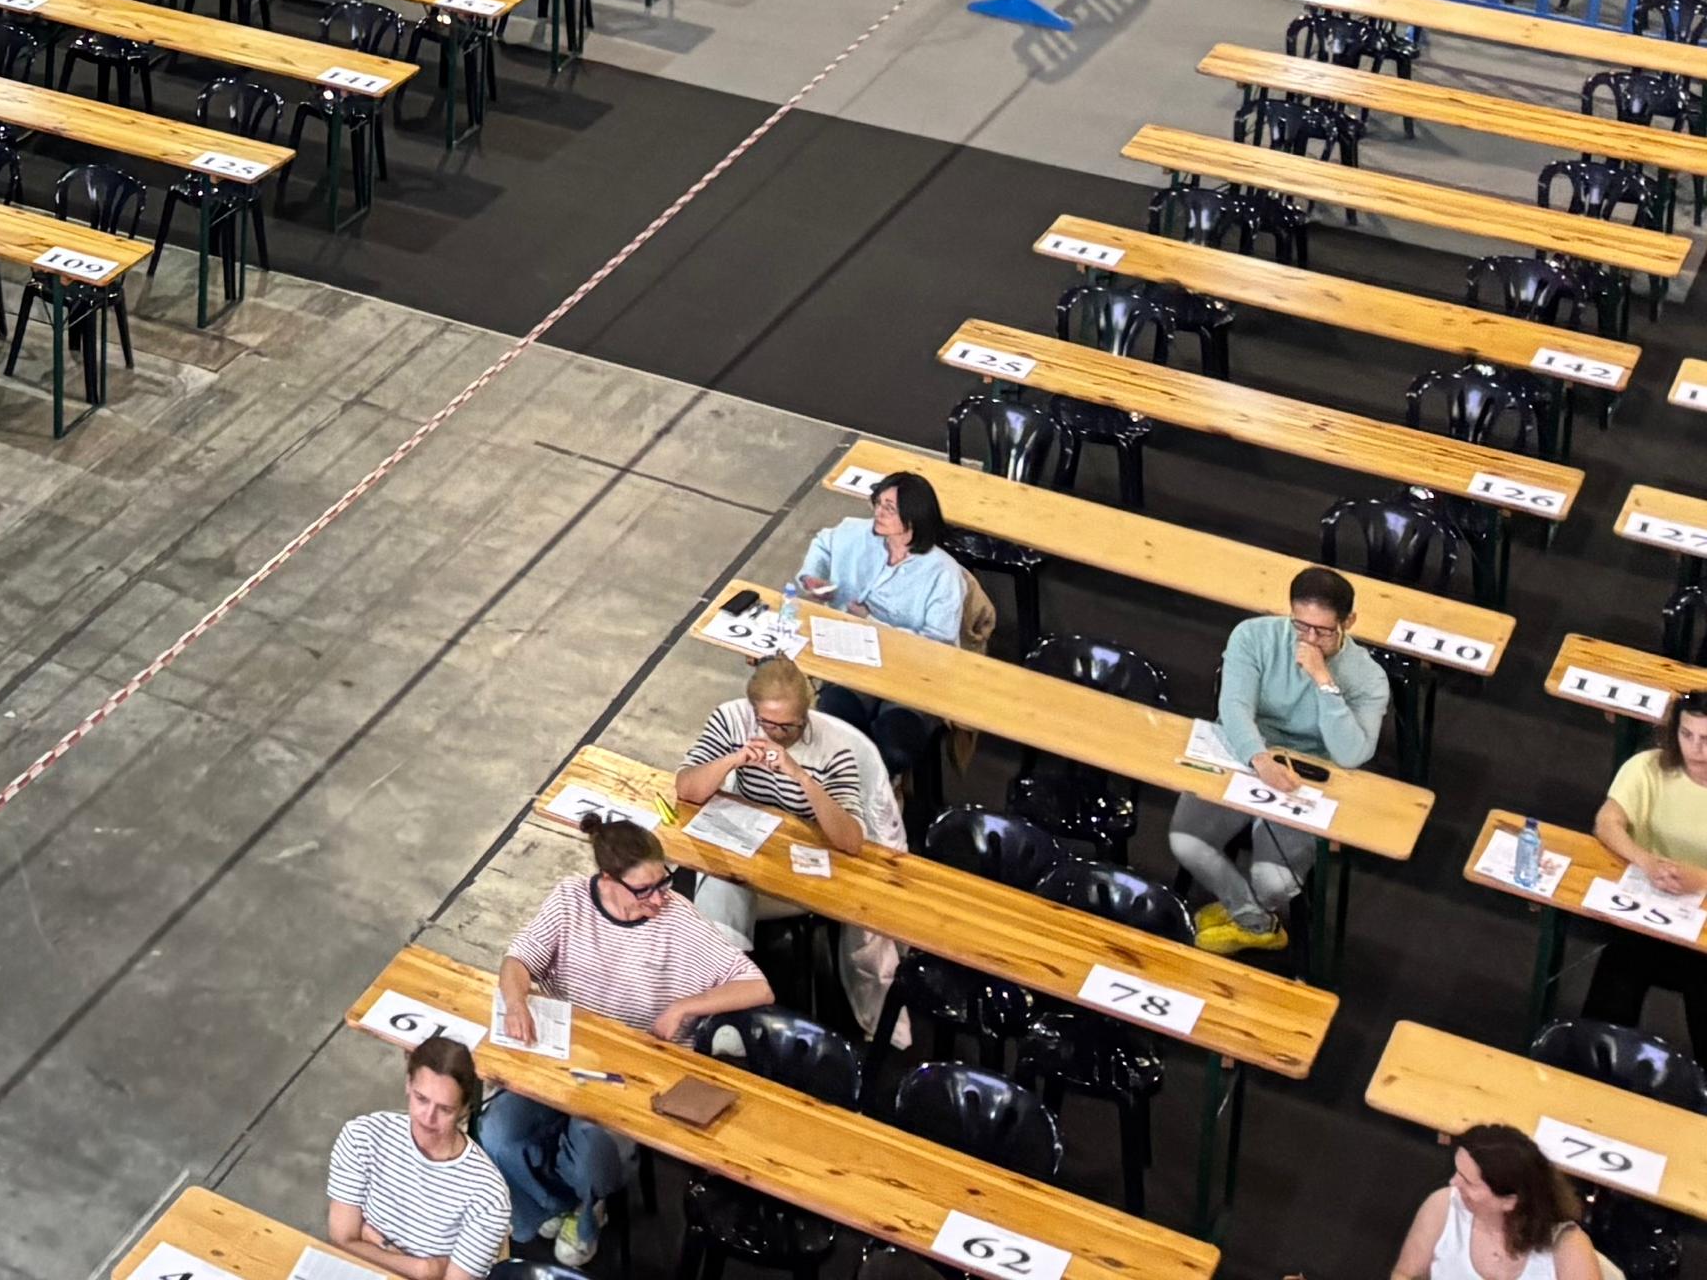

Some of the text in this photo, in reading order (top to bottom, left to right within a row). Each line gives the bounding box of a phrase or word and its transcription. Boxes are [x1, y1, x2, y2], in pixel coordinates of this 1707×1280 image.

[330, 73, 375, 87] 141
[203, 158, 252, 173] 125
[1053, 241, 1107, 259] 141
[48, 254, 104, 272] 109
[959, 350, 1021, 371] 125
[1546, 357, 1609, 376] 142
[1483, 483, 1552, 506] 126
[728, 625, 778, 648] 93
[1404, 631, 1482, 660] 110
[1577, 678, 1650, 708] 111
[1111, 982, 1171, 1015] 78
[1563, 1137, 1633, 1171] 79
[963, 1238, 1031, 1275] 62
